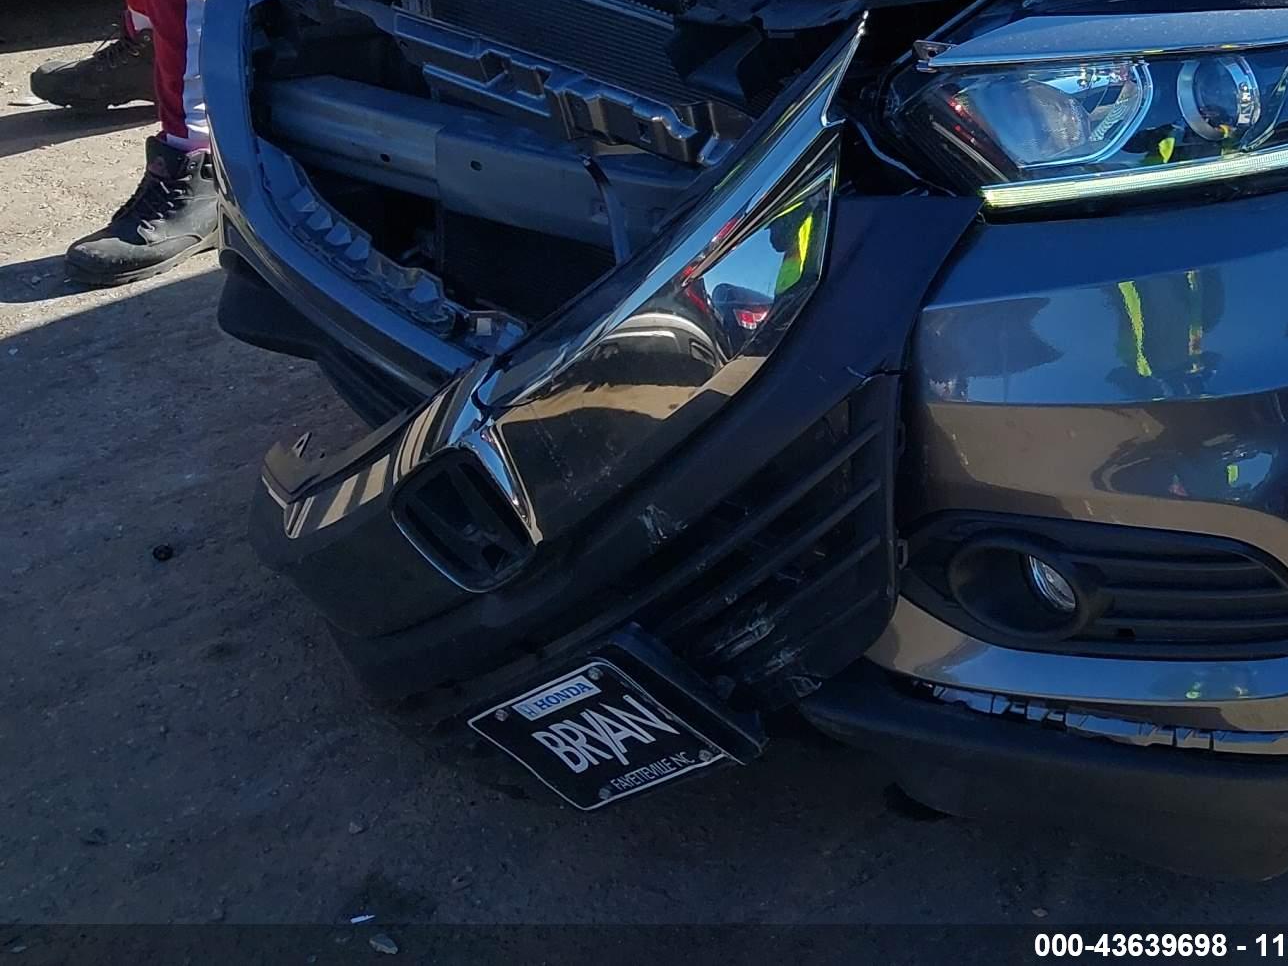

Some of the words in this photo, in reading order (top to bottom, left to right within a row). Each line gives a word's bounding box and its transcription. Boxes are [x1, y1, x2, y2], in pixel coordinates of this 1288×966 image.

[532, 682, 592, 711] HONDA
[531, 694, 680, 773] BRYAN
[610, 758, 676, 791] FAYETTEVILLE
[673, 751, 695, 770] NC
